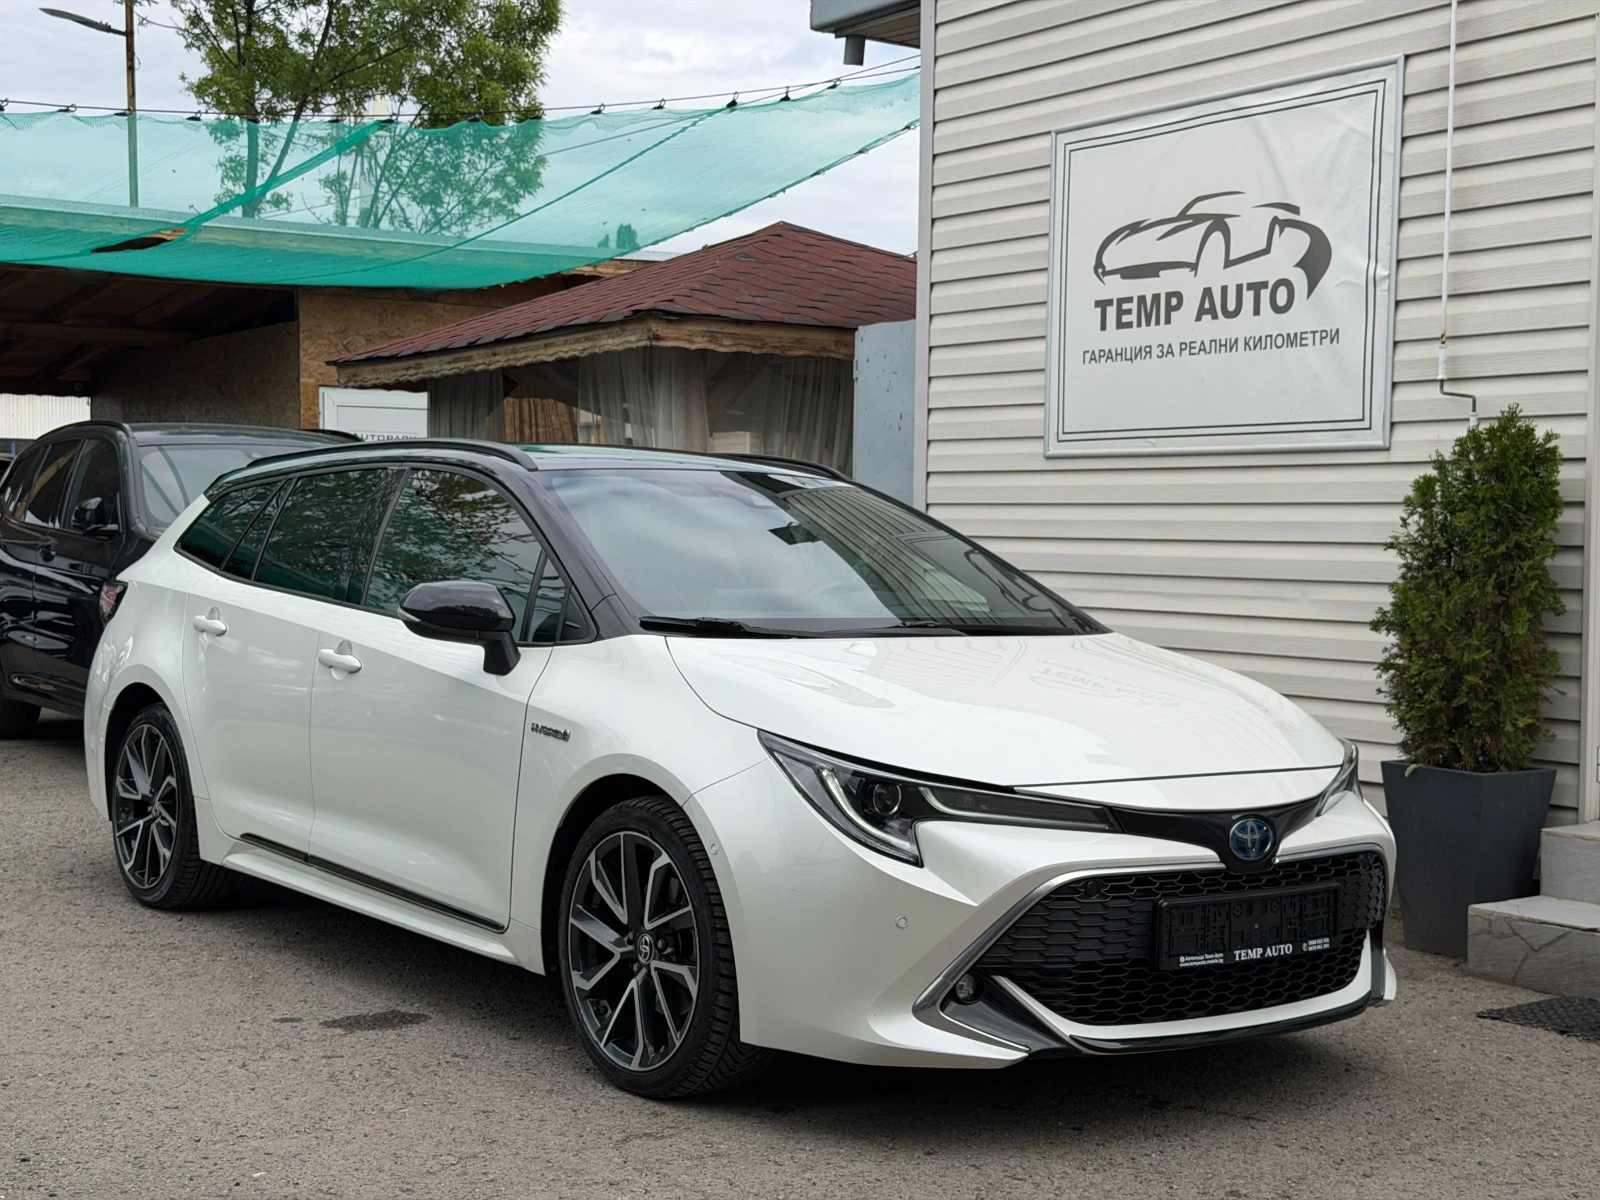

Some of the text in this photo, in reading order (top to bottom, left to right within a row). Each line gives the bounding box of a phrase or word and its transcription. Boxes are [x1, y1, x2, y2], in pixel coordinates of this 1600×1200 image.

[1094, 278, 1295, 332] TEMP AUTO
[1082, 328, 1340, 365] ГАРАНЦИЯ ЗА РЕАЛНИ КИЛОМЕТРИ
[1233, 947, 1263, 962] TEMP
[1264, 943, 1293, 957] AUTO
